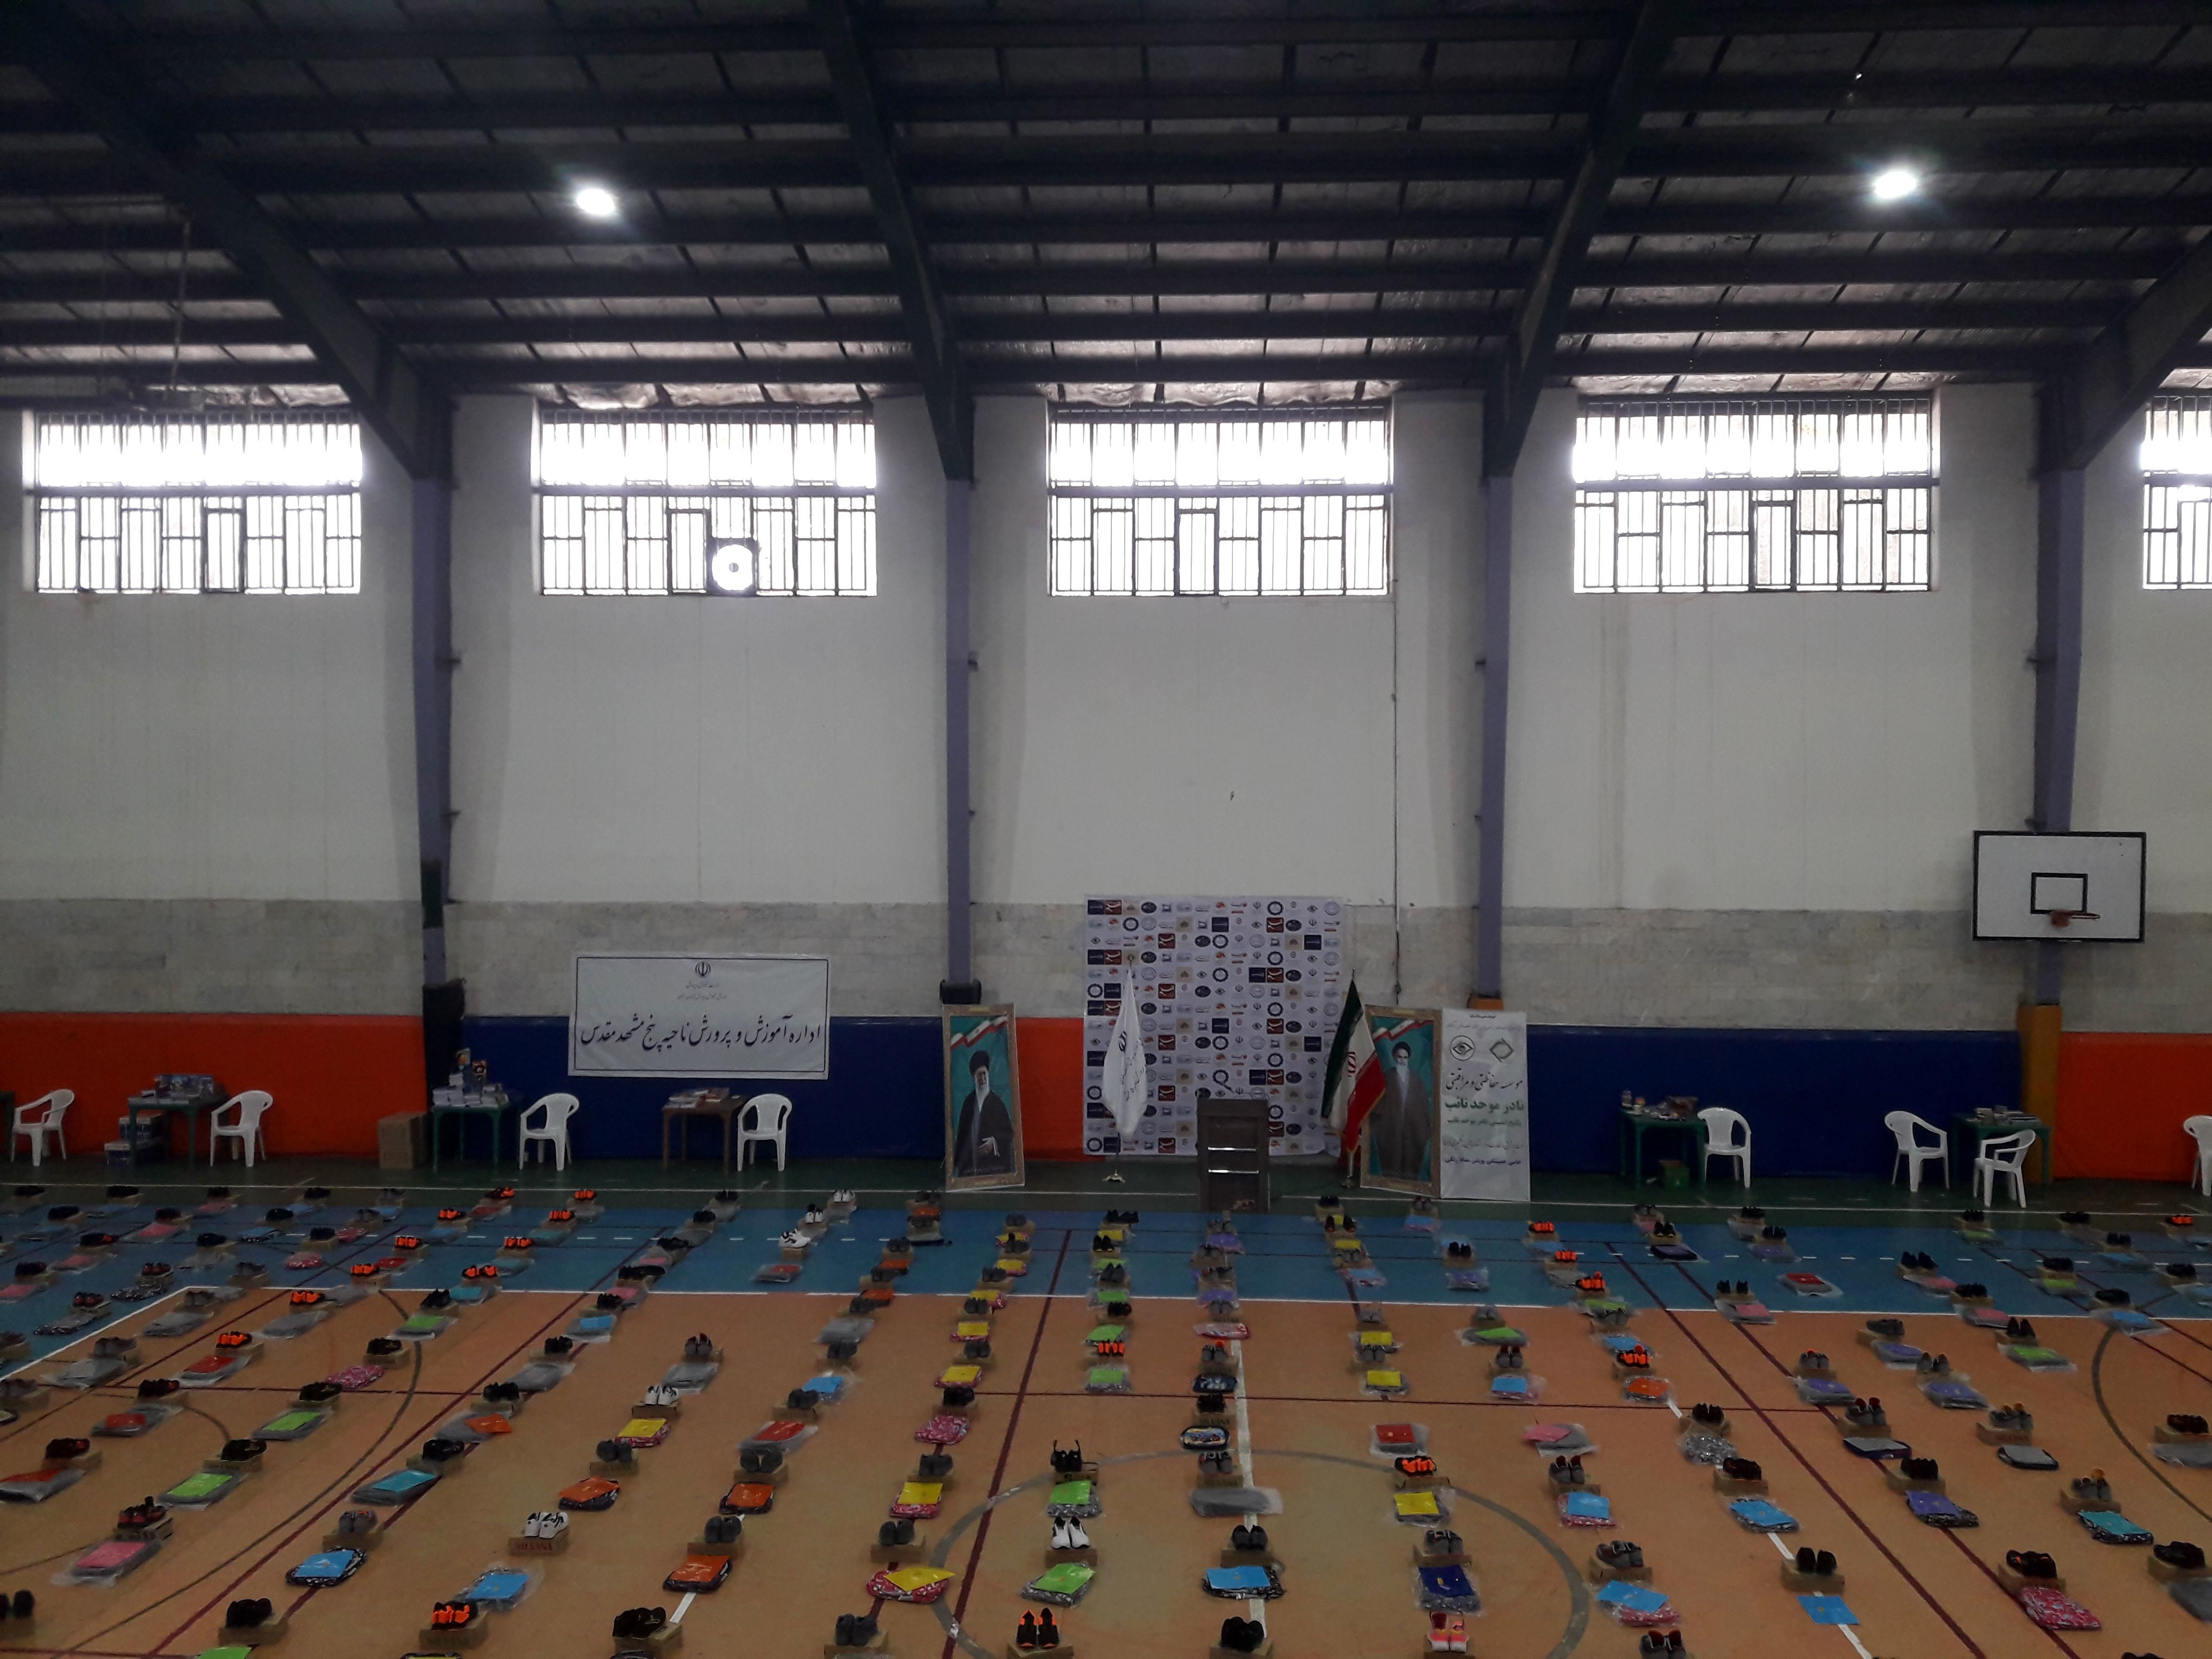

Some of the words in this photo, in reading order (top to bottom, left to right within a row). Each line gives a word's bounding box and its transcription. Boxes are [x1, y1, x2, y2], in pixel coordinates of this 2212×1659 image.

[581, 1021, 616, 1044] مقدس
[616, 1013, 644, 1042] مشهد
[642, 1014, 662, 1052] پنج
[661, 1022, 690, 1049] ناحیه
[689, 1014, 731, 1048] پرورش
[735, 1030, 742, 1042] و
[744, 1014, 793, 1047] آموزش
[789, 1024, 820, 1043] اداره
